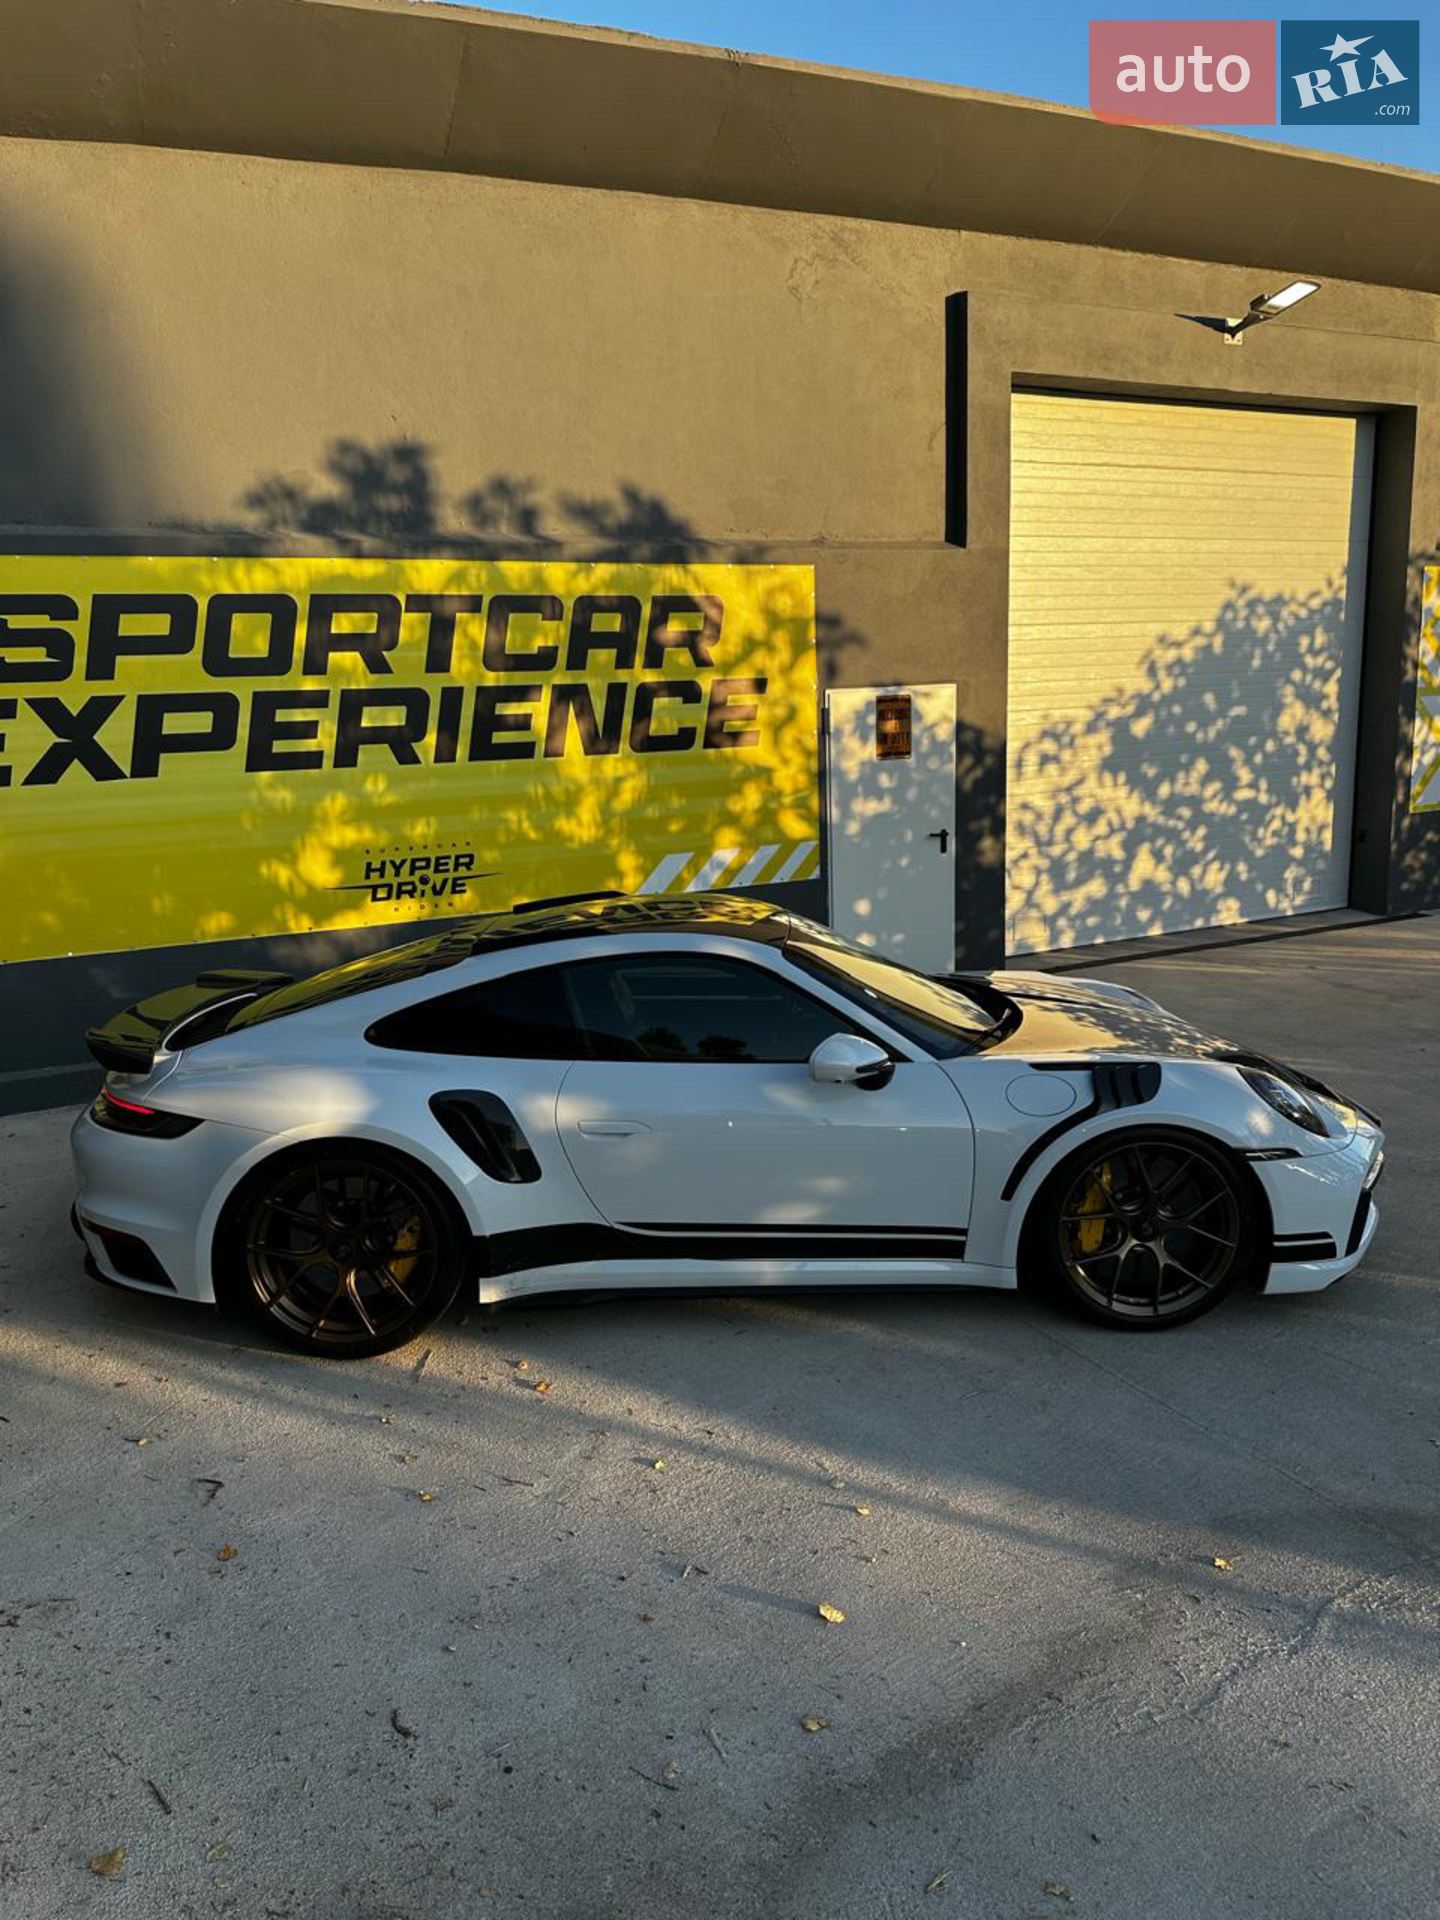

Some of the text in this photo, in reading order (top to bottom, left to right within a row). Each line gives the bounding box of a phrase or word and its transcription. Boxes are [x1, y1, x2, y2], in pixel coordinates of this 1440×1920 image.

[0, 594, 724, 683] SPORTCAR
[0, 677, 769, 787] XPERIENCE
[364, 852, 475, 880] HYPER
